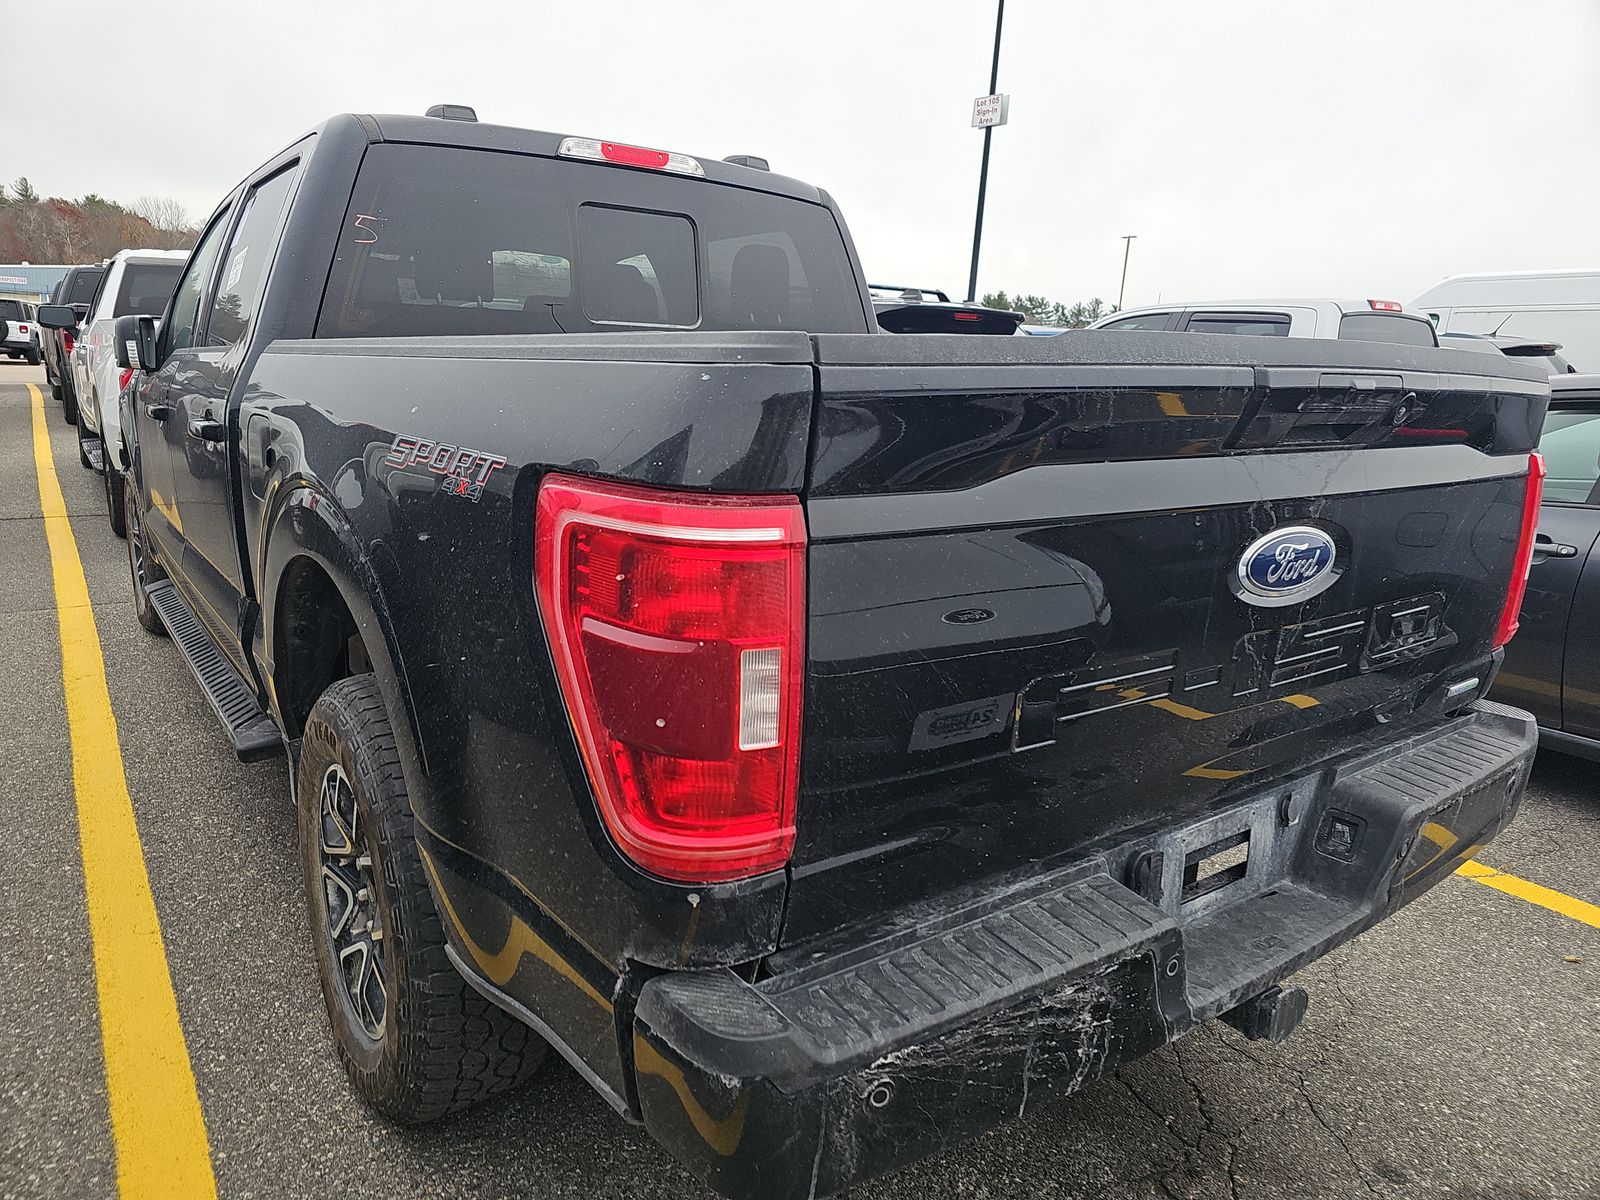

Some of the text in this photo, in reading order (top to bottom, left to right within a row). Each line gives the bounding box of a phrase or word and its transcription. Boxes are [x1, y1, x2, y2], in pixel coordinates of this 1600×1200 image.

[977, 96, 1000, 107] Lot 105
[978, 117, 993, 125] Area
[385, 433, 507, 486] SPORT
[1267, 543, 1320, 583] Ford
